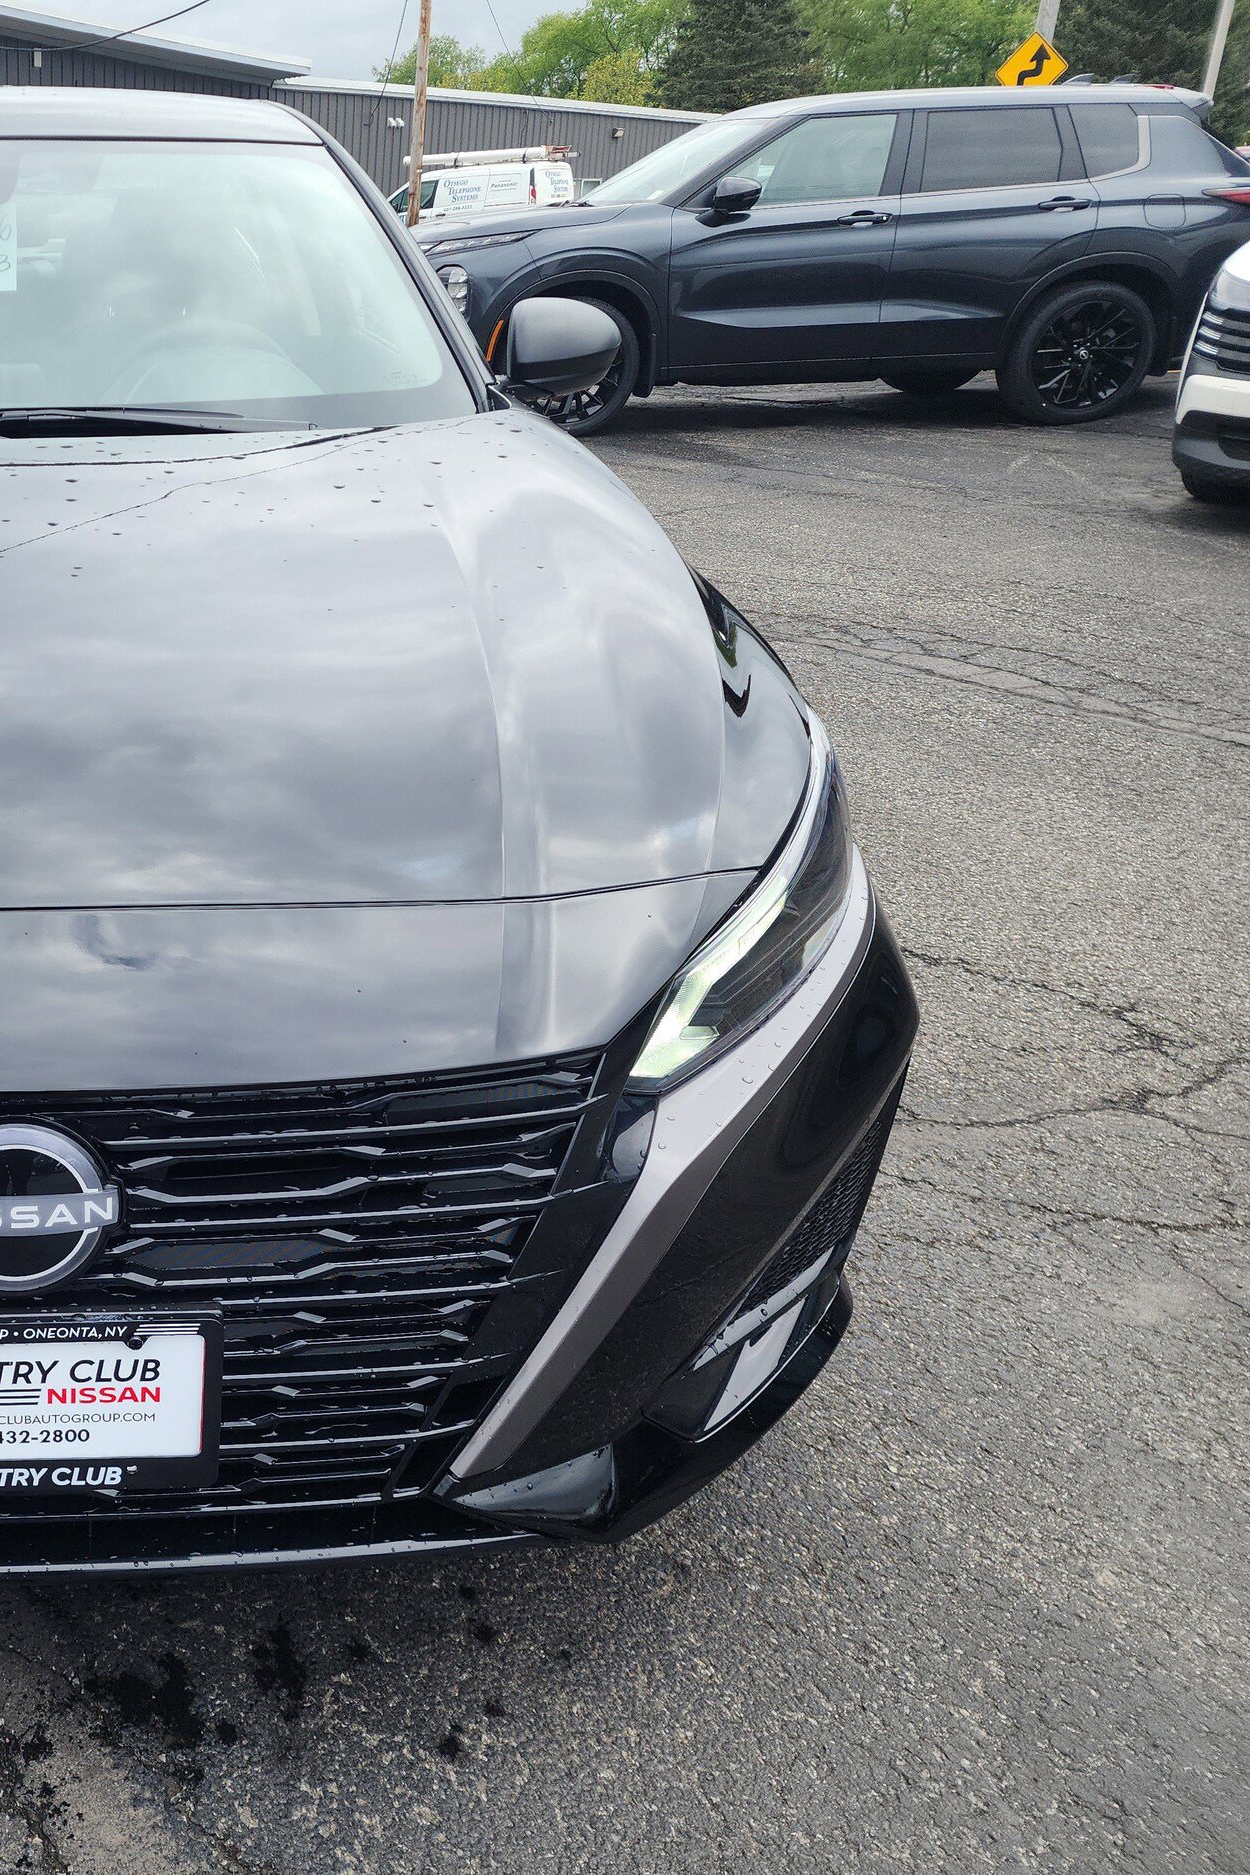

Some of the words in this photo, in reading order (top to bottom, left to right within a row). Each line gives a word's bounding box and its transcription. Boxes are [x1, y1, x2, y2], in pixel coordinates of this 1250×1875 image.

[69, 1358, 161, 1383] CLUB
[47, 1386, 161, 1405] NISSAN
[51, 1466, 123, 1486] CLUB
